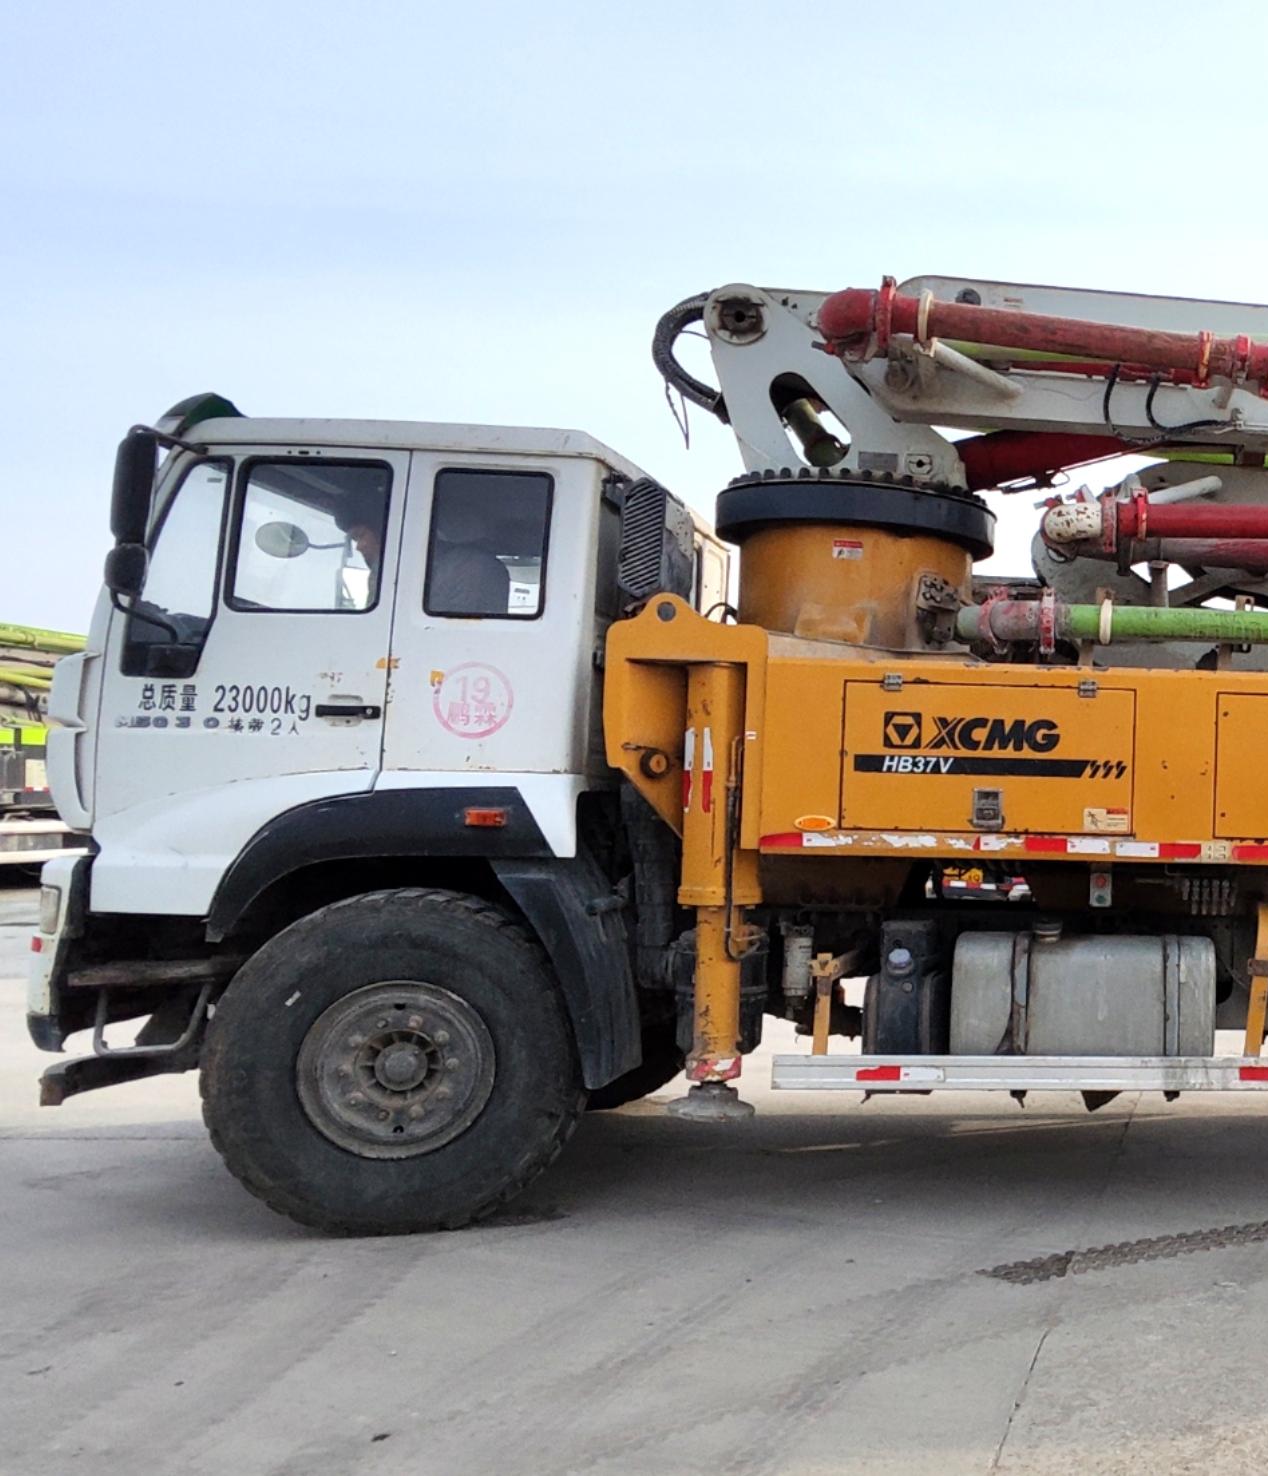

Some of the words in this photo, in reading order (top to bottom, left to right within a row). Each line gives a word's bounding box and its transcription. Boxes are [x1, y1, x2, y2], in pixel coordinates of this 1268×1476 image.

[138, 684, 198, 712] 总质量
[213, 685, 311, 722] 23000kg
[924, 716, 1060, 752] XCMG
[882, 756, 954, 774] HB37V
